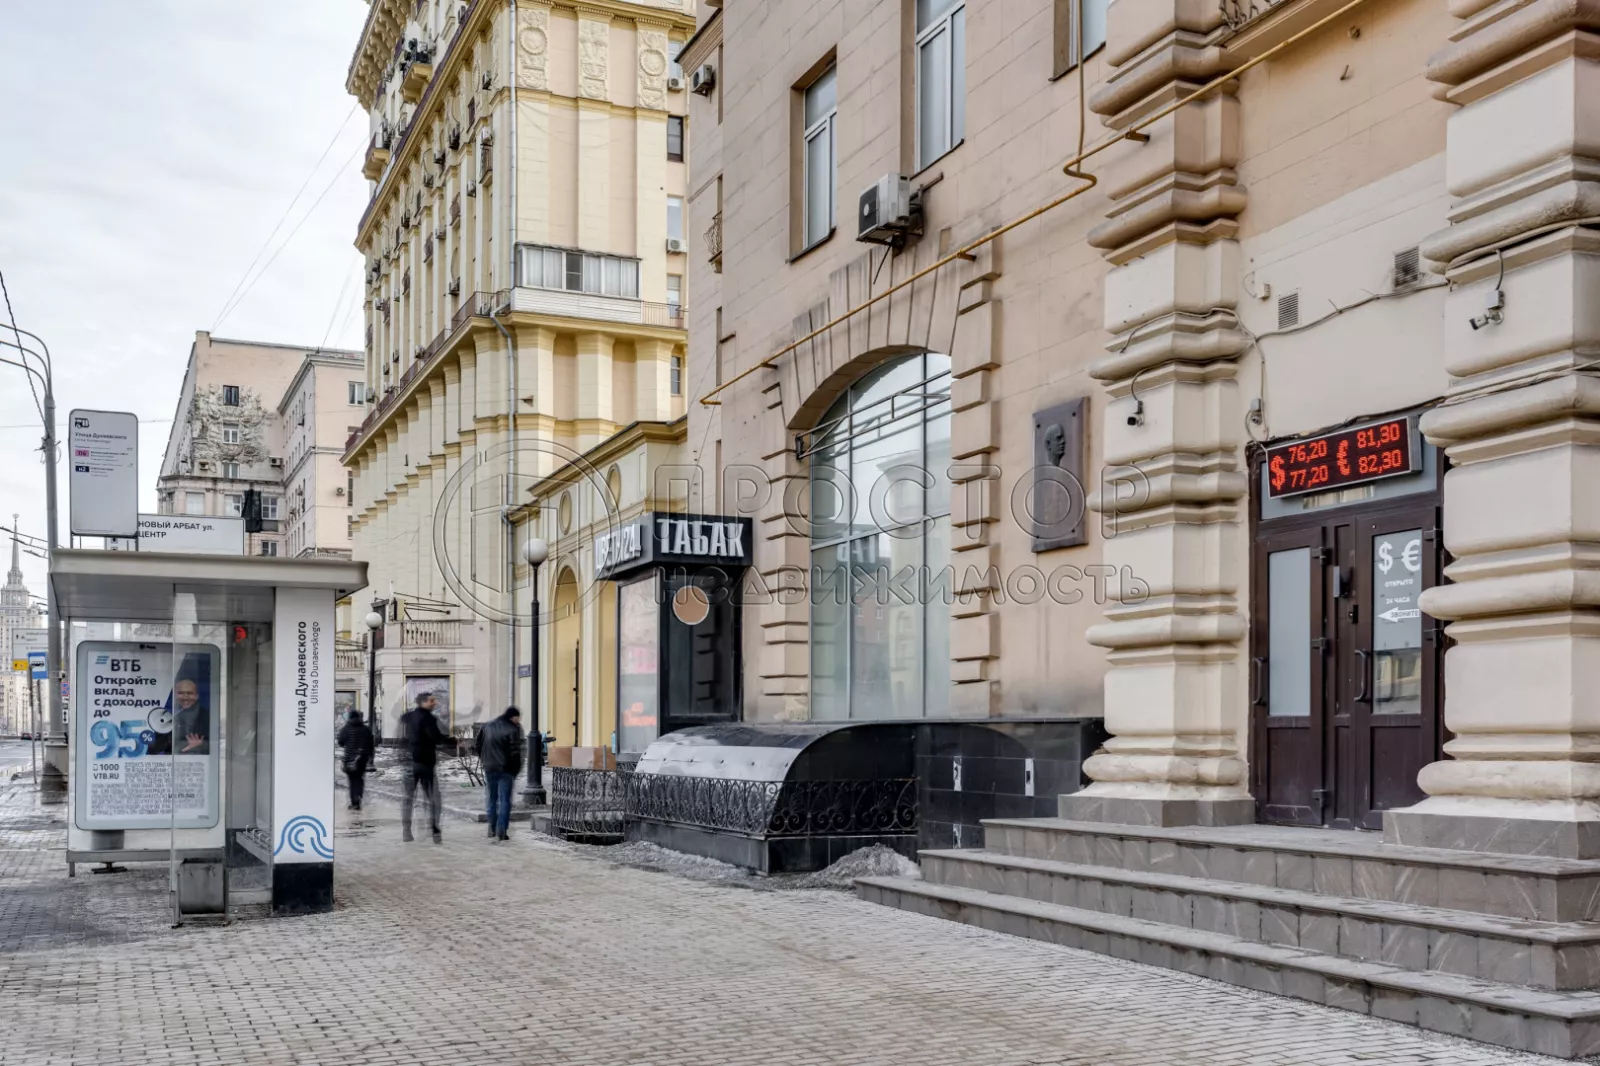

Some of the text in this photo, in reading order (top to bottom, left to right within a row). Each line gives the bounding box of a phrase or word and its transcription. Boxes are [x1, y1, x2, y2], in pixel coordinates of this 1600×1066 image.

[1356, 423, 1400, 449] 81,30
[1288, 440, 1327, 464] 76,20
[1359, 449, 1402, 474] 82,30
[1270, 455, 1286, 490] $
[1290, 465, 1329, 488] 77,20
[138, 521, 171, 529] НОВЫЙ
[656, 518, 745, 558] ТАБАК
[1378, 539, 1421, 575] $ €
[1384, 579, 1414, 588] ОТКРЫТО
[110, 659, 141, 672] ВТБ
[310, 621, 321, 704] Ulitsa Dunaevskogo
[94, 675, 157, 687] Откройте
[295, 621, 309, 737] Улица Дунаевского
[94, 688, 135, 697] вклад
[102, 699, 160, 707] доходом
[93, 709, 111, 718] до
[141, 732, 153, 742] %
[99, 763, 120, 771] 1000
